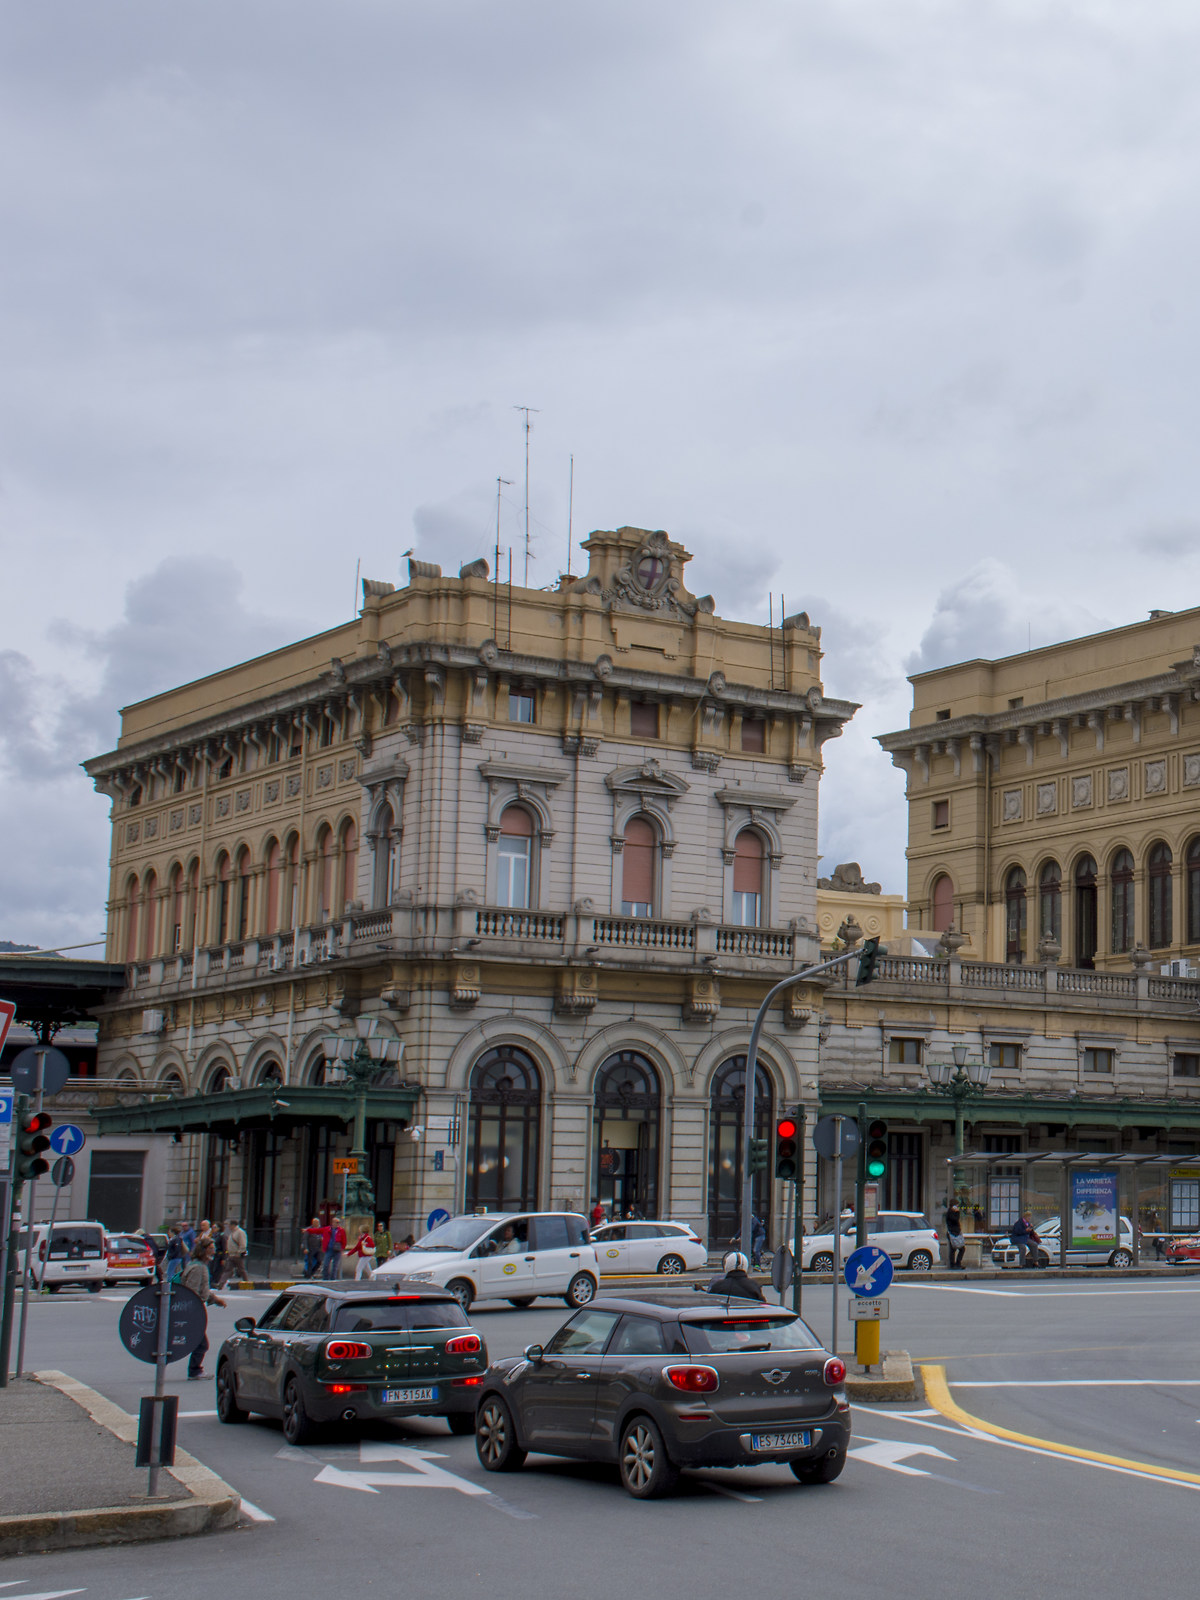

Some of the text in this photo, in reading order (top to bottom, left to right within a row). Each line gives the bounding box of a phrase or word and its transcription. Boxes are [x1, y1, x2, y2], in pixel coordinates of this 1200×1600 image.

[335, 1162, 357, 1170] TAXI
[388, 1390, 400, 1401] FN
[759, 1433, 803, 1447] ES 734CR
